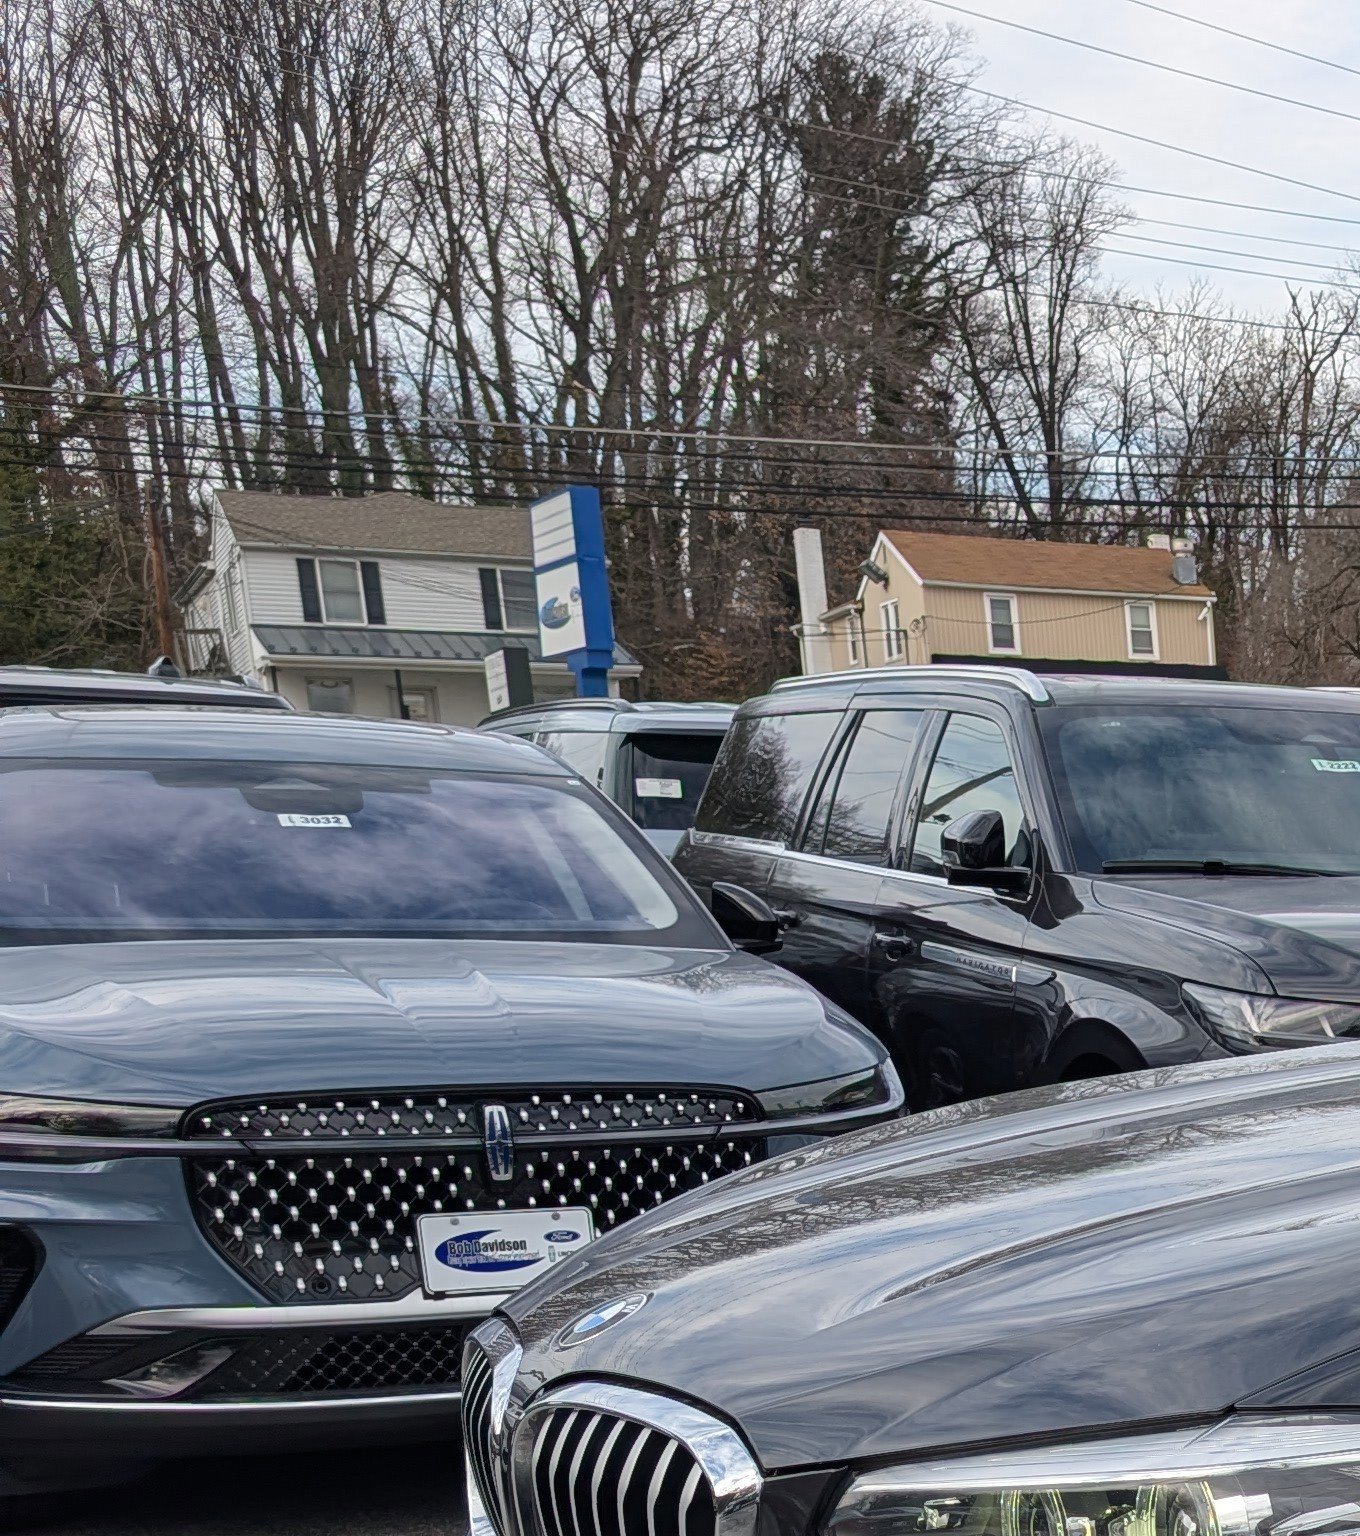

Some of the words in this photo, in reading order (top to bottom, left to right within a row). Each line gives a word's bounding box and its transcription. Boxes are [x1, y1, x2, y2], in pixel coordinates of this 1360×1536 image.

[299, 816, 343, 824] 3032
[955, 957, 1009, 975] NAVIGATOR
[551, 1231, 573, 1241] Ford
[448, 1240, 473, 1255] Bob
[473, 1239, 528, 1253] Davidson
